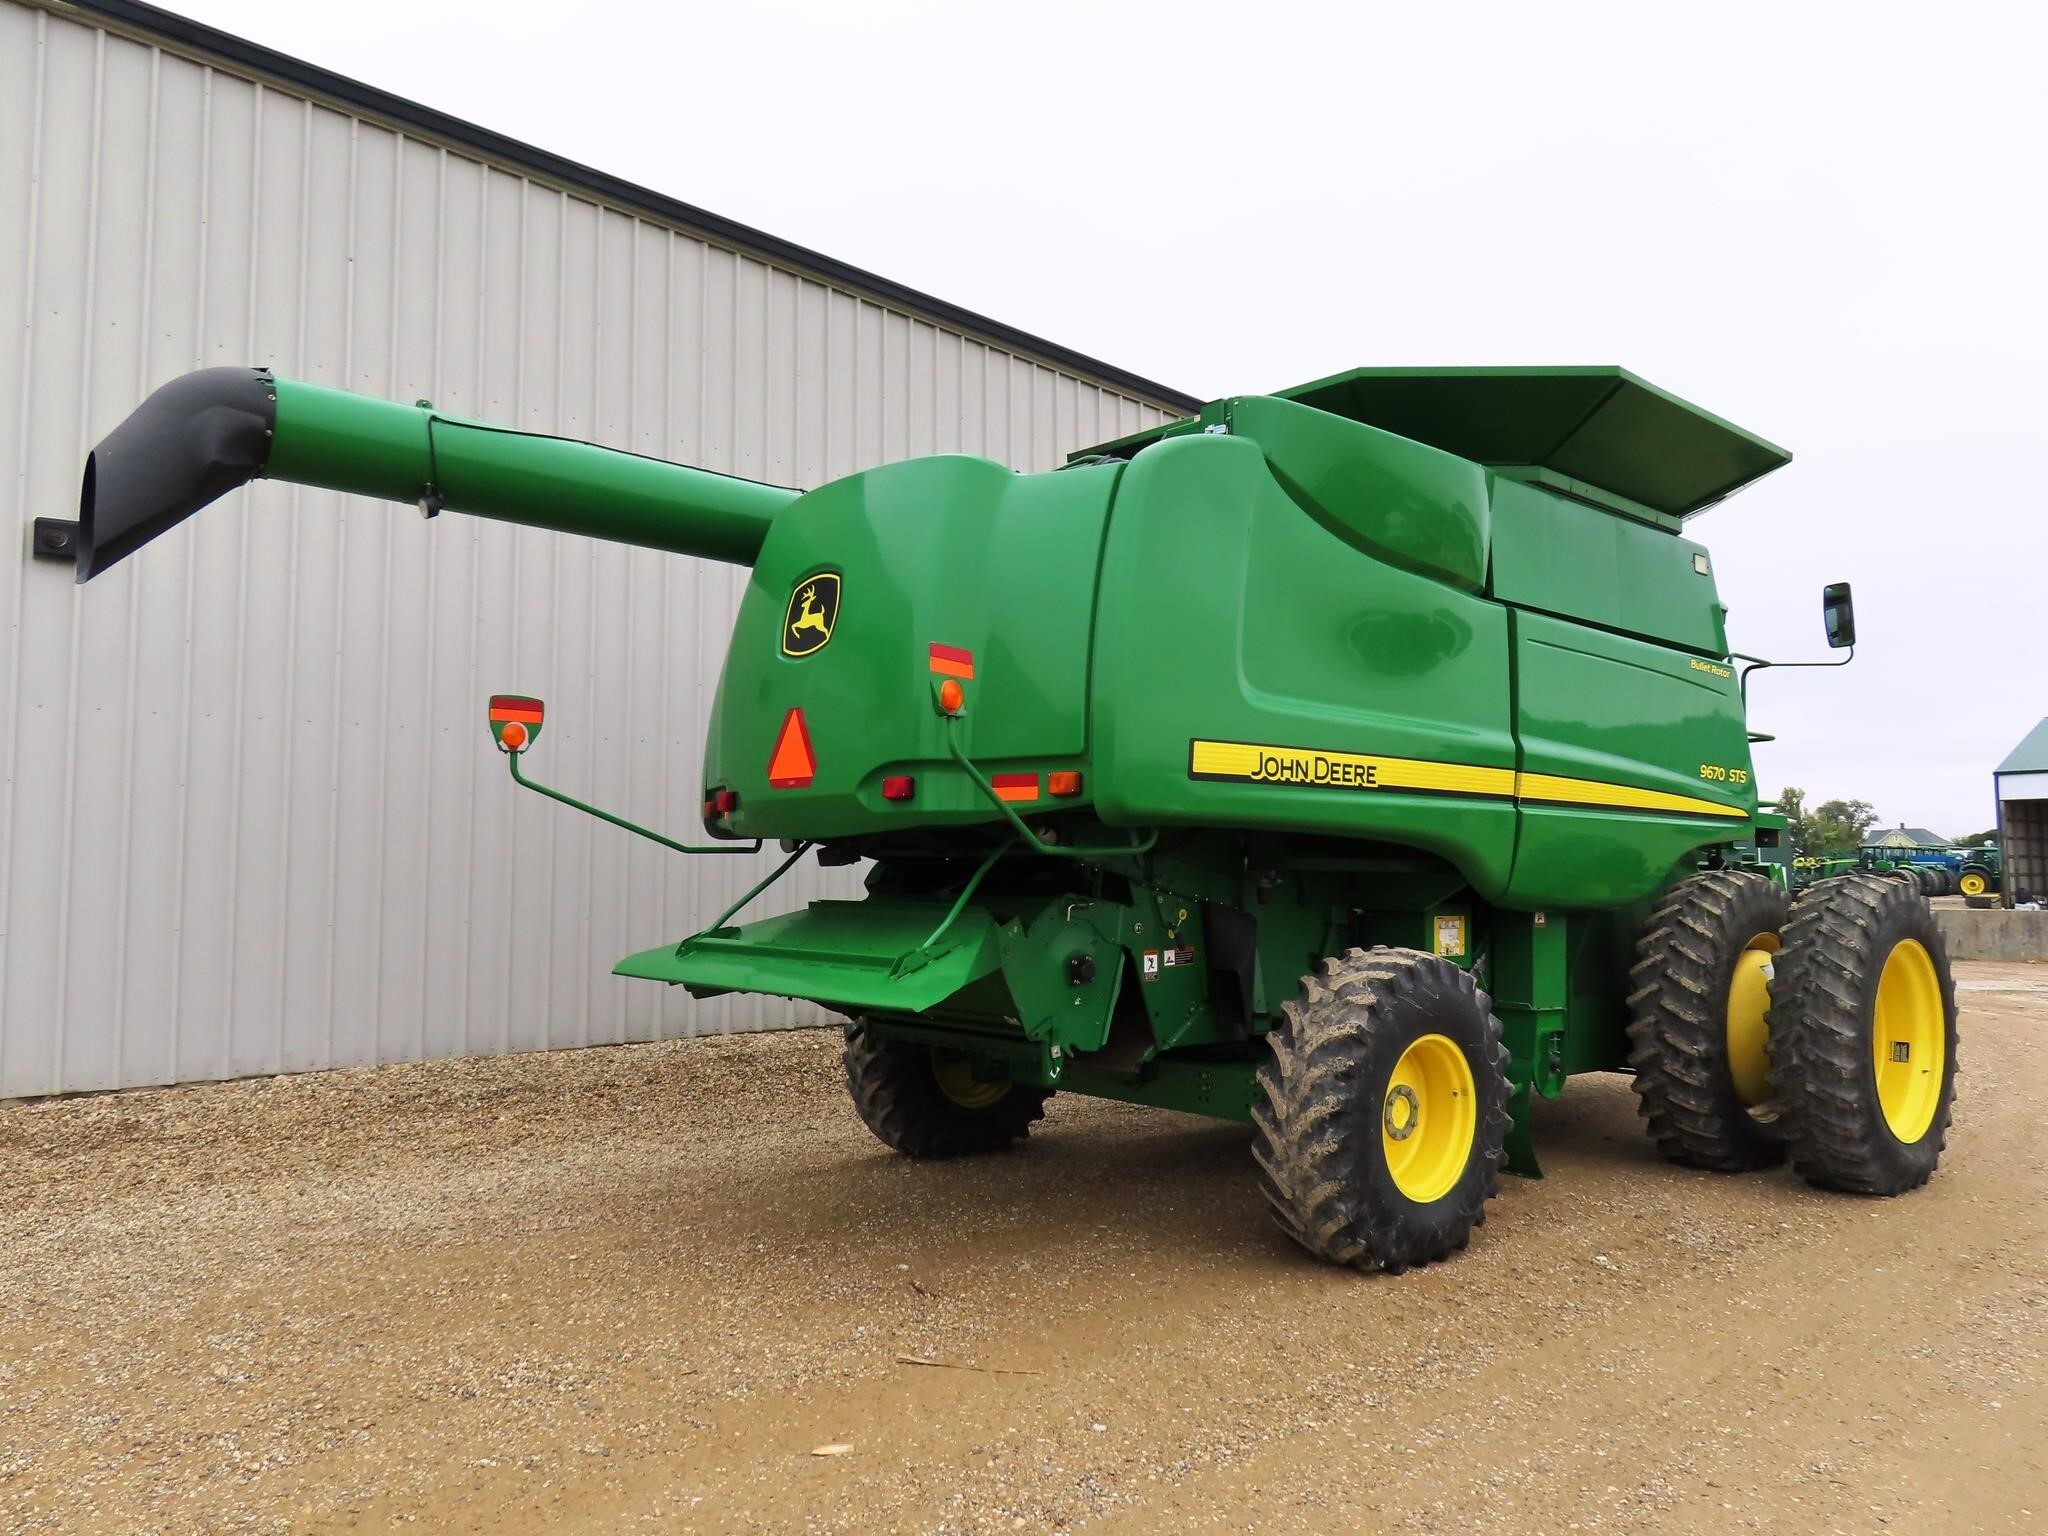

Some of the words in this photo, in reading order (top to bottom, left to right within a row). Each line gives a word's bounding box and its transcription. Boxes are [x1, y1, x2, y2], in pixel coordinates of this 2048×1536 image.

[1690, 659, 1710, 672] Bullet
[1711, 664, 1730, 678] Rotor
[1251, 752, 1309, 780] JOHN
[1314, 757, 1377, 785] DEERE
[1700, 764, 1725, 781] 9670
[1729, 769, 1747, 784] STS
